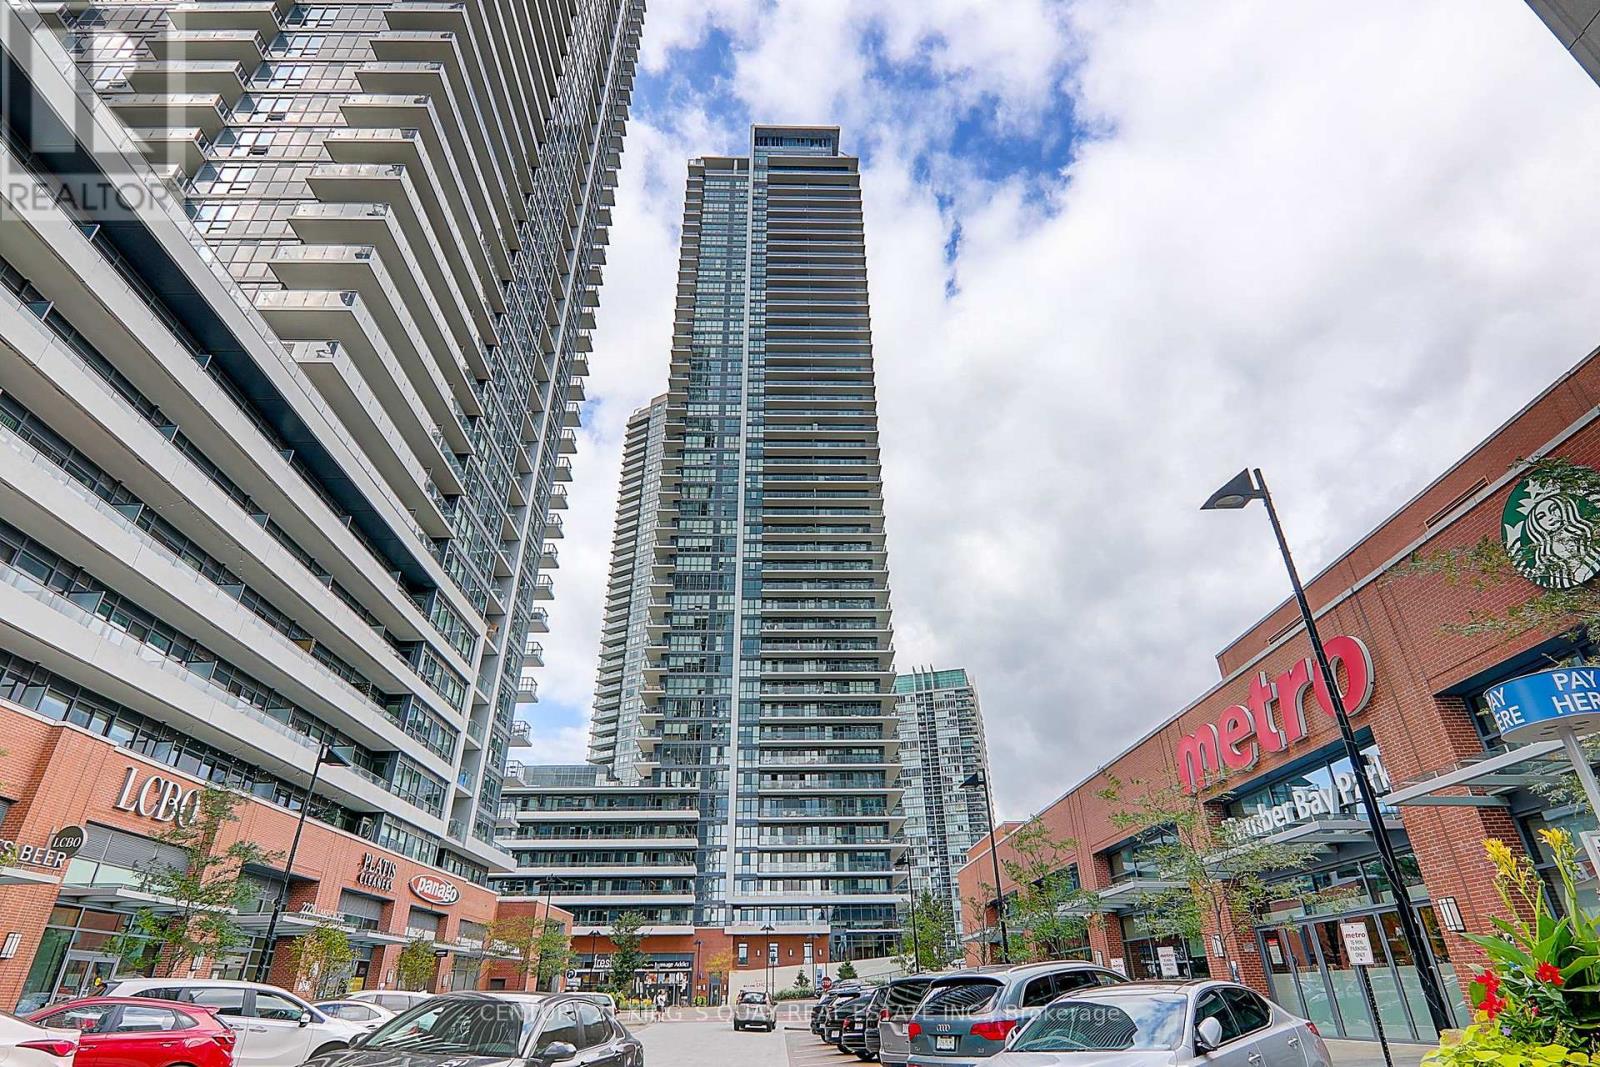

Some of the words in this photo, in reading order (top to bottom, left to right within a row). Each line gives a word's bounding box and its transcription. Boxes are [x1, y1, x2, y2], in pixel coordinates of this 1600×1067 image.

[1552, 670, 1597, 691] PAY
[1176, 635, 1375, 795] metro
[113, 765, 202, 829] LCBO
[1291, 784, 1340, 820] Bay
[52, 835, 82, 849] LCBO
[19, 844, 67, 869] BEER
[359, 872, 394, 892] CLEANERS
[417, 876, 458, 903] panago
